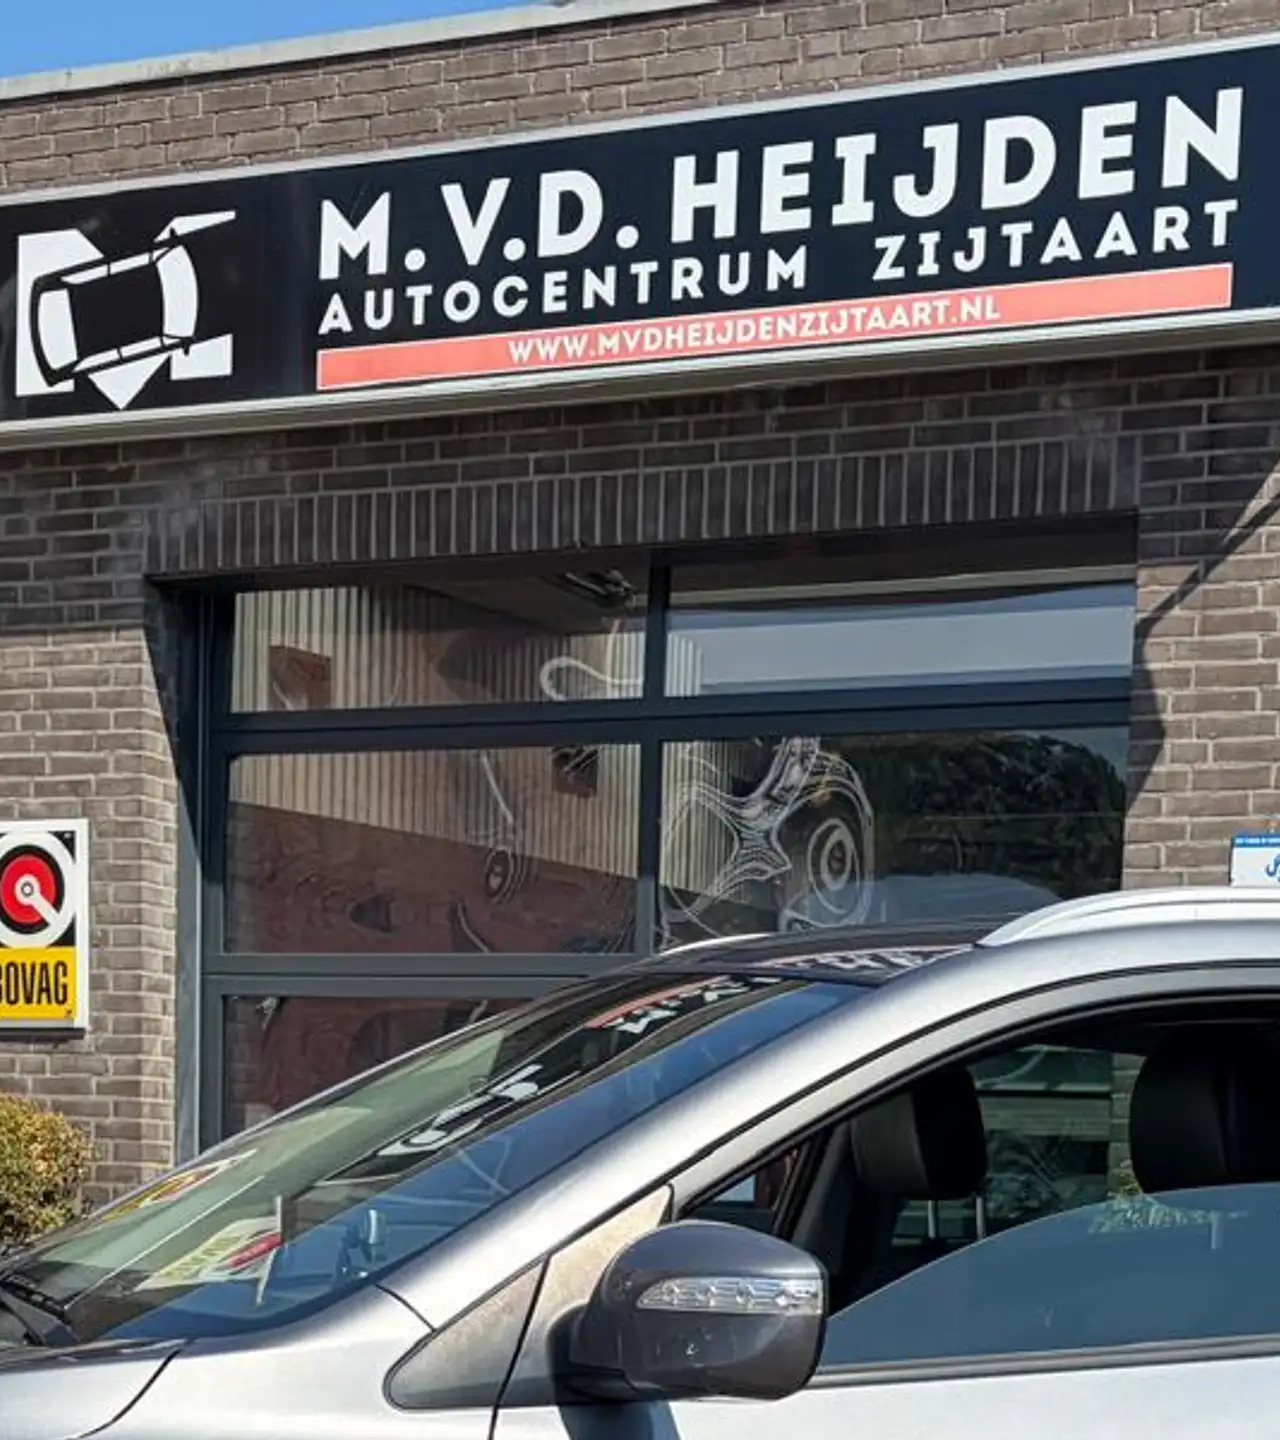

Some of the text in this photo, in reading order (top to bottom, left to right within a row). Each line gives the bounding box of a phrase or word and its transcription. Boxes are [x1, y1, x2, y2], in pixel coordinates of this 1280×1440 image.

[319, 169, 639, 281] M.V.D.
[670, 86, 1243, 243] HEIJDEN
[318, 199, 1240, 336] AUTOCENTRUM ZIJTAART
[508, 294, 1001, 364] WWW.MVDHEIJDENZIJTAART.NL
